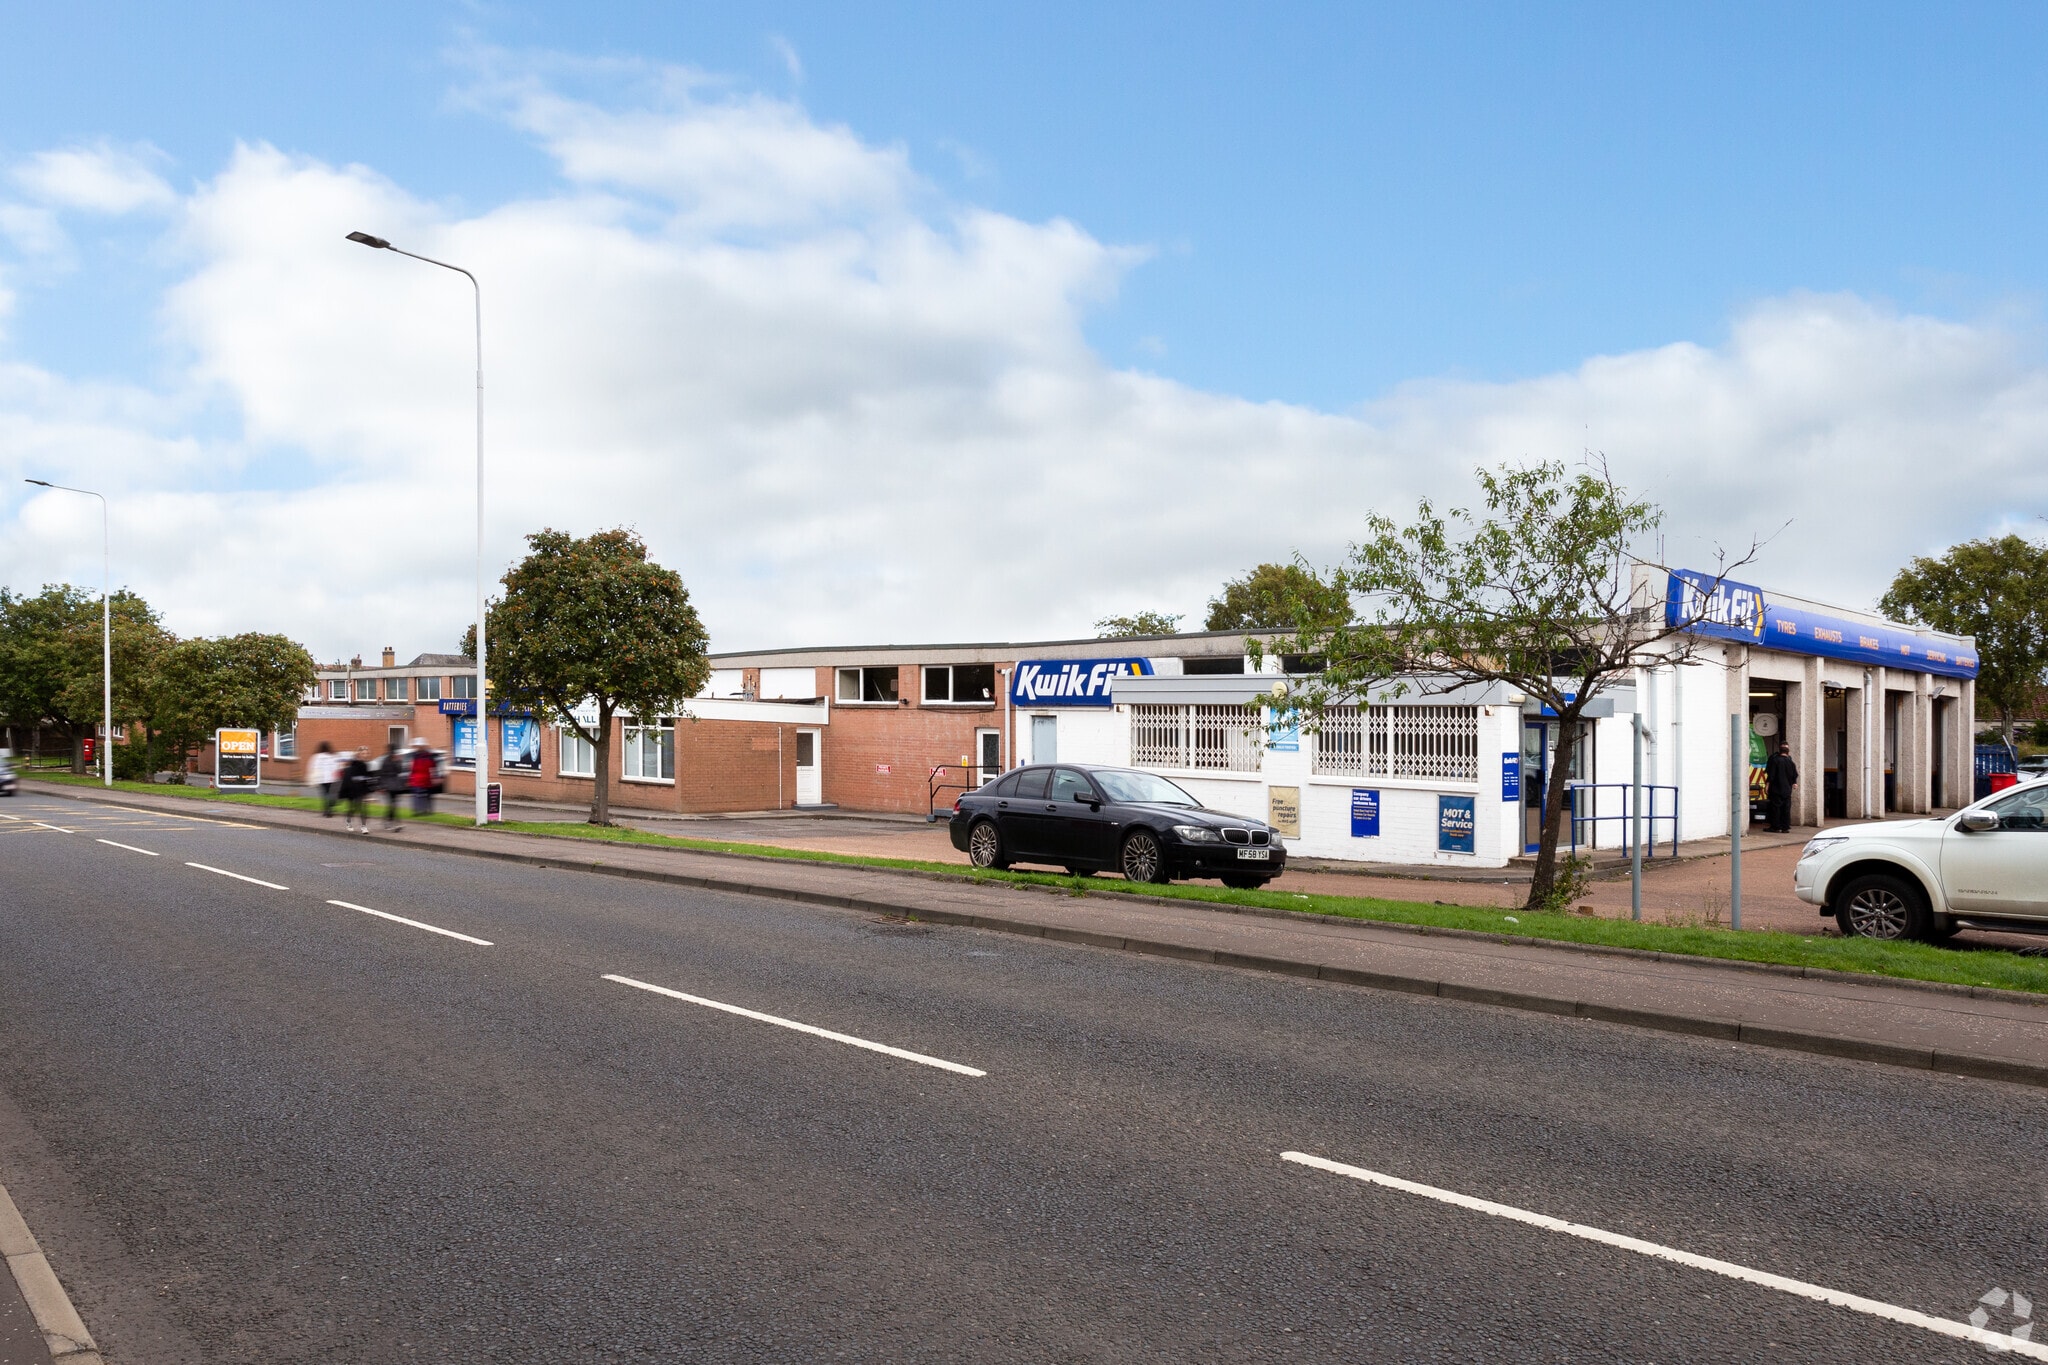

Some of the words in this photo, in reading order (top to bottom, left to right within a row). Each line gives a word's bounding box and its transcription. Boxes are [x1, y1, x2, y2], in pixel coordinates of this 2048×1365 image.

[1776, 619, 1797, 635] TYRES
[1814, 626, 1843, 644] EXHAUSTS
[1859, 635, 1879, 650] BRAKES
[221, 741, 255, 751] OPEN
[1443, 808, 1464, 818] MOT
[1464, 809, 1471, 818] &
[1441, 818, 1473, 829] Service
[1239, 850, 1257, 859] MF58
